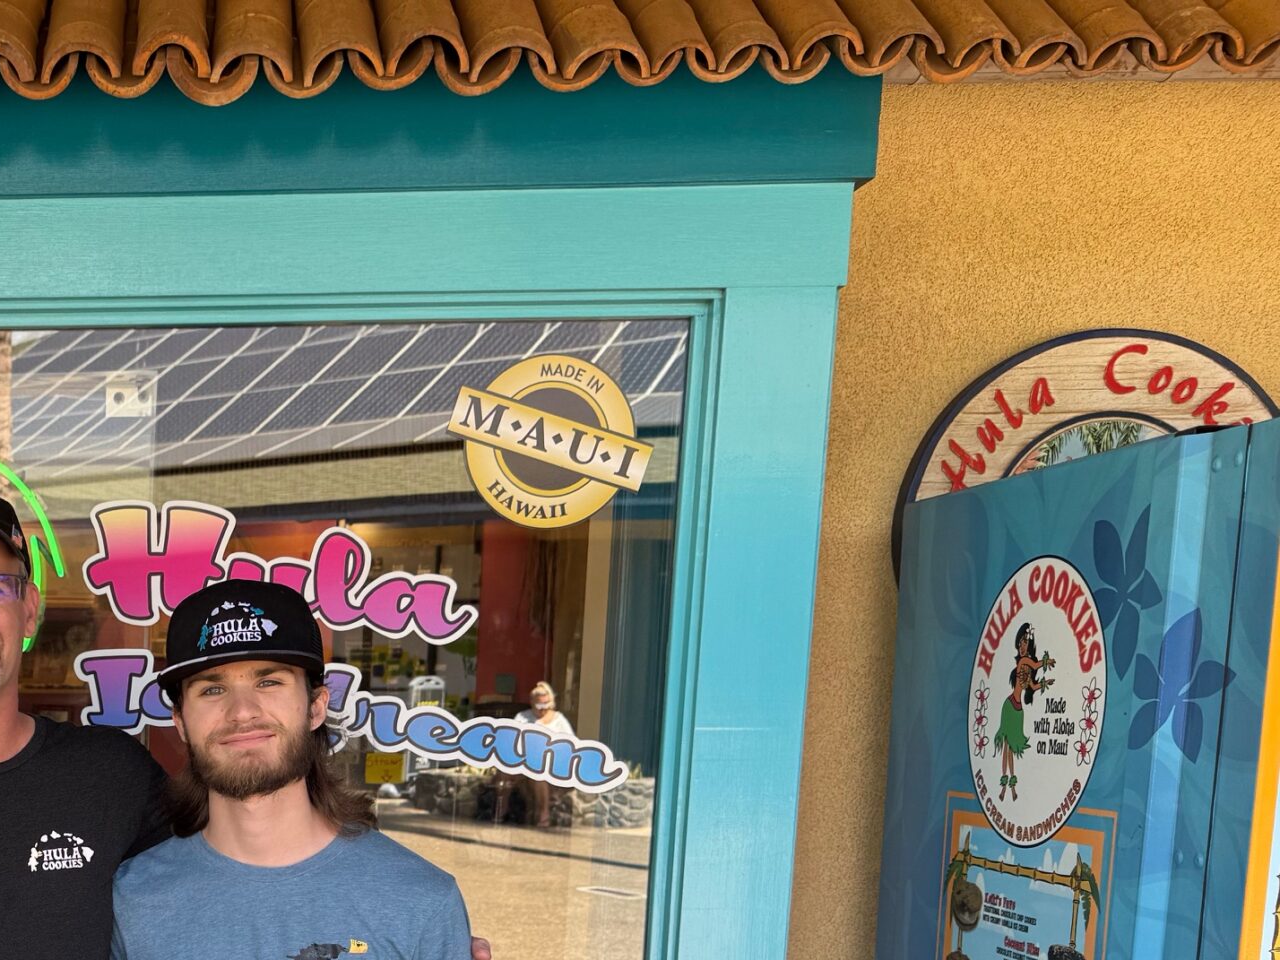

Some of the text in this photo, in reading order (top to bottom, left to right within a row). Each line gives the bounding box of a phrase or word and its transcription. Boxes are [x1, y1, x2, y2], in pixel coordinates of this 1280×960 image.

[540, 363, 605, 394] MADE IN
[941, 378, 1055, 492] Hula
[486, 479, 568, 519] HAWAII
[212, 617, 261, 637] HULA
[976, 564, 1103, 679] HULA COOKIES
[210, 632, 262, 646] COOKIES
[1044, 697, 1066, 715] Made
[1033, 717, 1075, 736] with Aloha
[1036, 738, 1068, 756] on Maui
[974, 768, 1082, 843] ICE CREAM SANDWICHES
[42, 846, 82, 860] HULA
[42, 858, 84, 870] COOKIES
